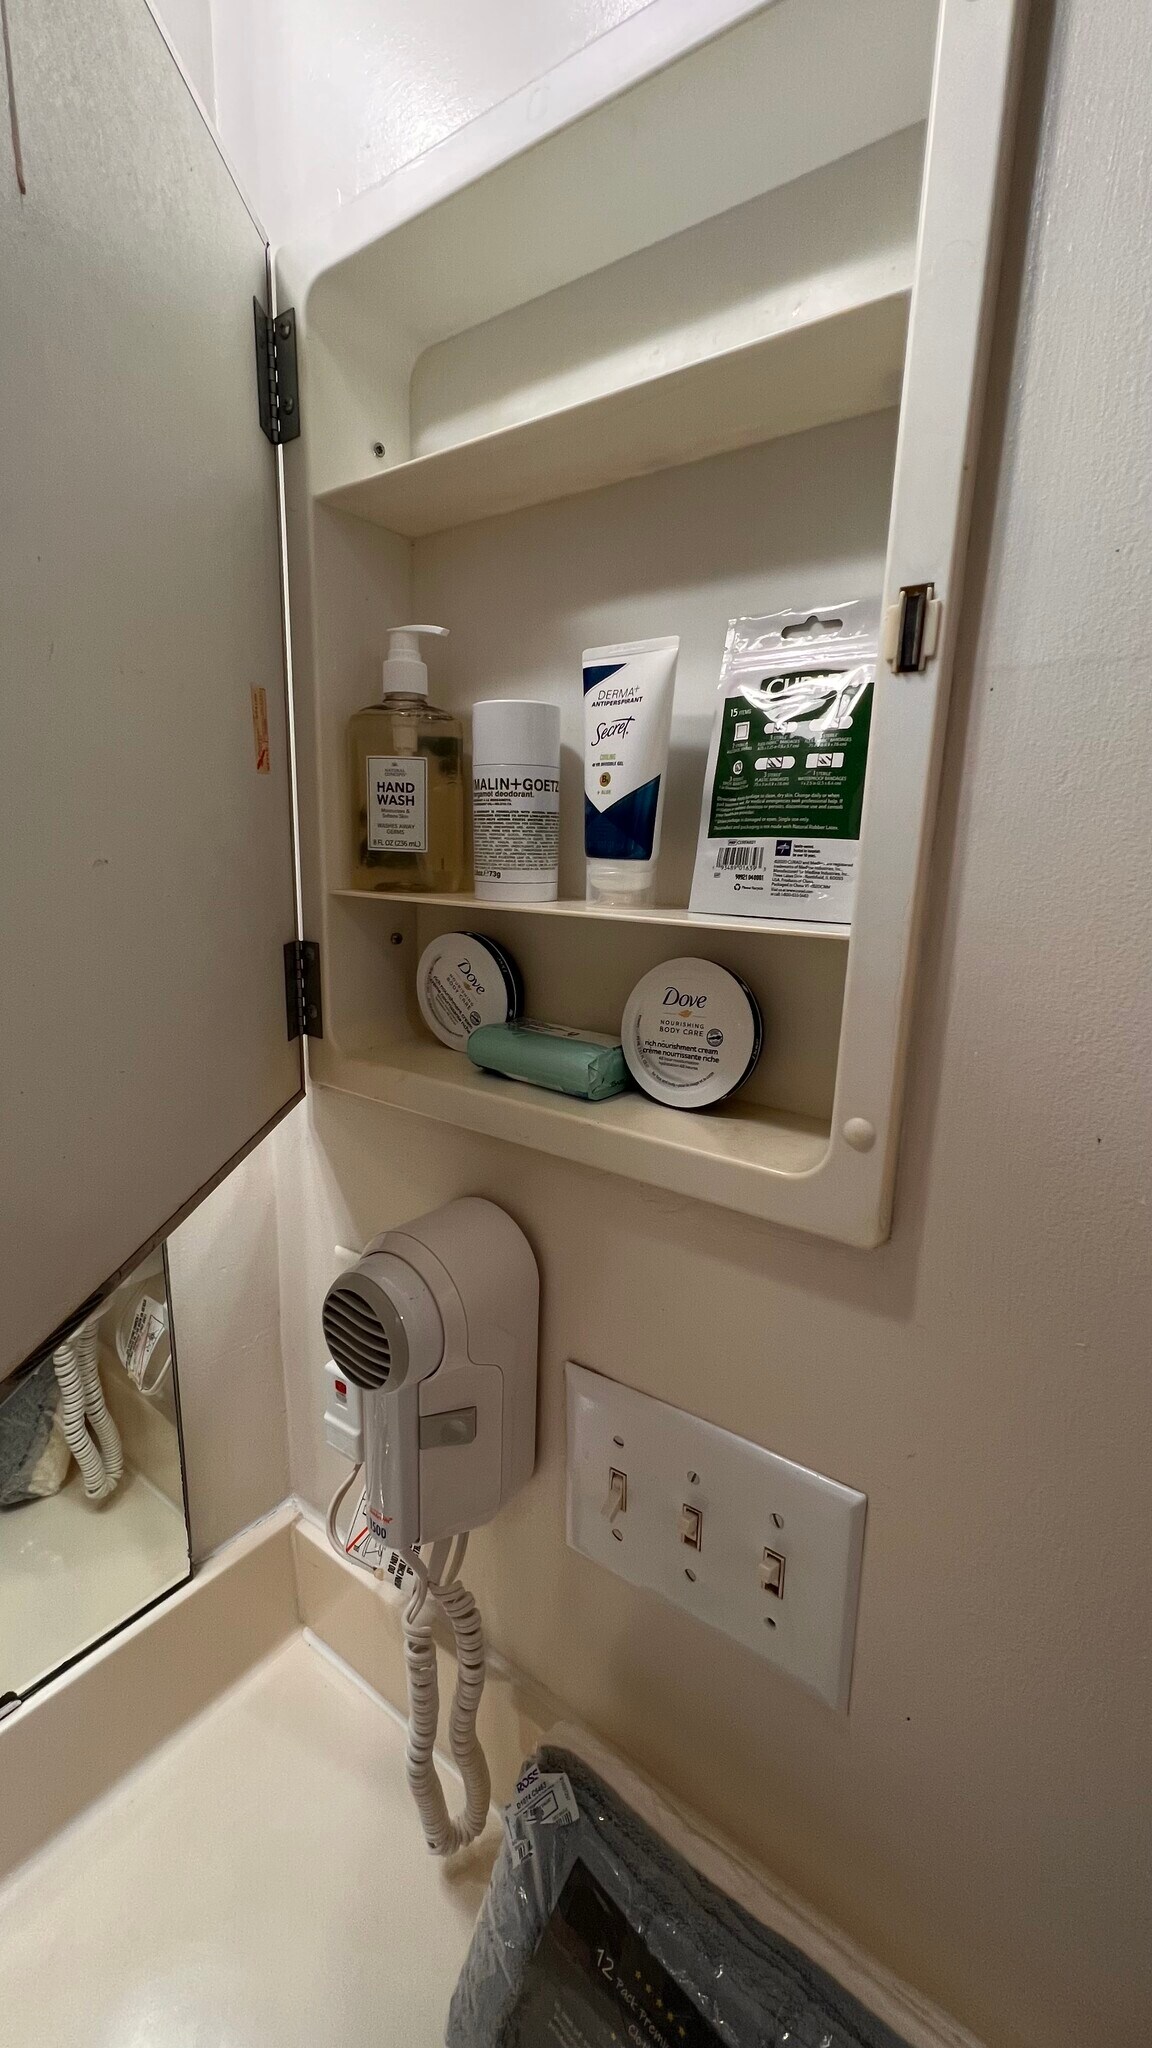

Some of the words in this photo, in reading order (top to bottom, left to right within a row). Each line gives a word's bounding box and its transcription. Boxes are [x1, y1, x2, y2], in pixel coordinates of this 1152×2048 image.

[598, 685, 640, 700] DERMA+
[592, 696, 643, 708] ANTIPERSPIRANT
[730, 708, 738, 718] 15
[377, 782, 415, 793] HAND
[377, 794, 415, 806] WASH
[458, 958, 486, 995] Dove
[662, 986, 708, 1008] Dove
[660, 1020, 704, 1030] NOURISHING
[682, 1028, 704, 1037] CARE
[657, 1041, 697, 1052] nourishment
[698, 1047, 718, 1055] cream
[702, 1056, 720, 1064] riche
[370, 1518, 386, 1538] 1500
[390, 1552, 400, 1566] NOT
[388, 1564, 396, 1574] DO
[516, 1768, 538, 1794] ROSS
[597, 1948, 614, 1981] 12
[616, 1976, 638, 2012] Pack
